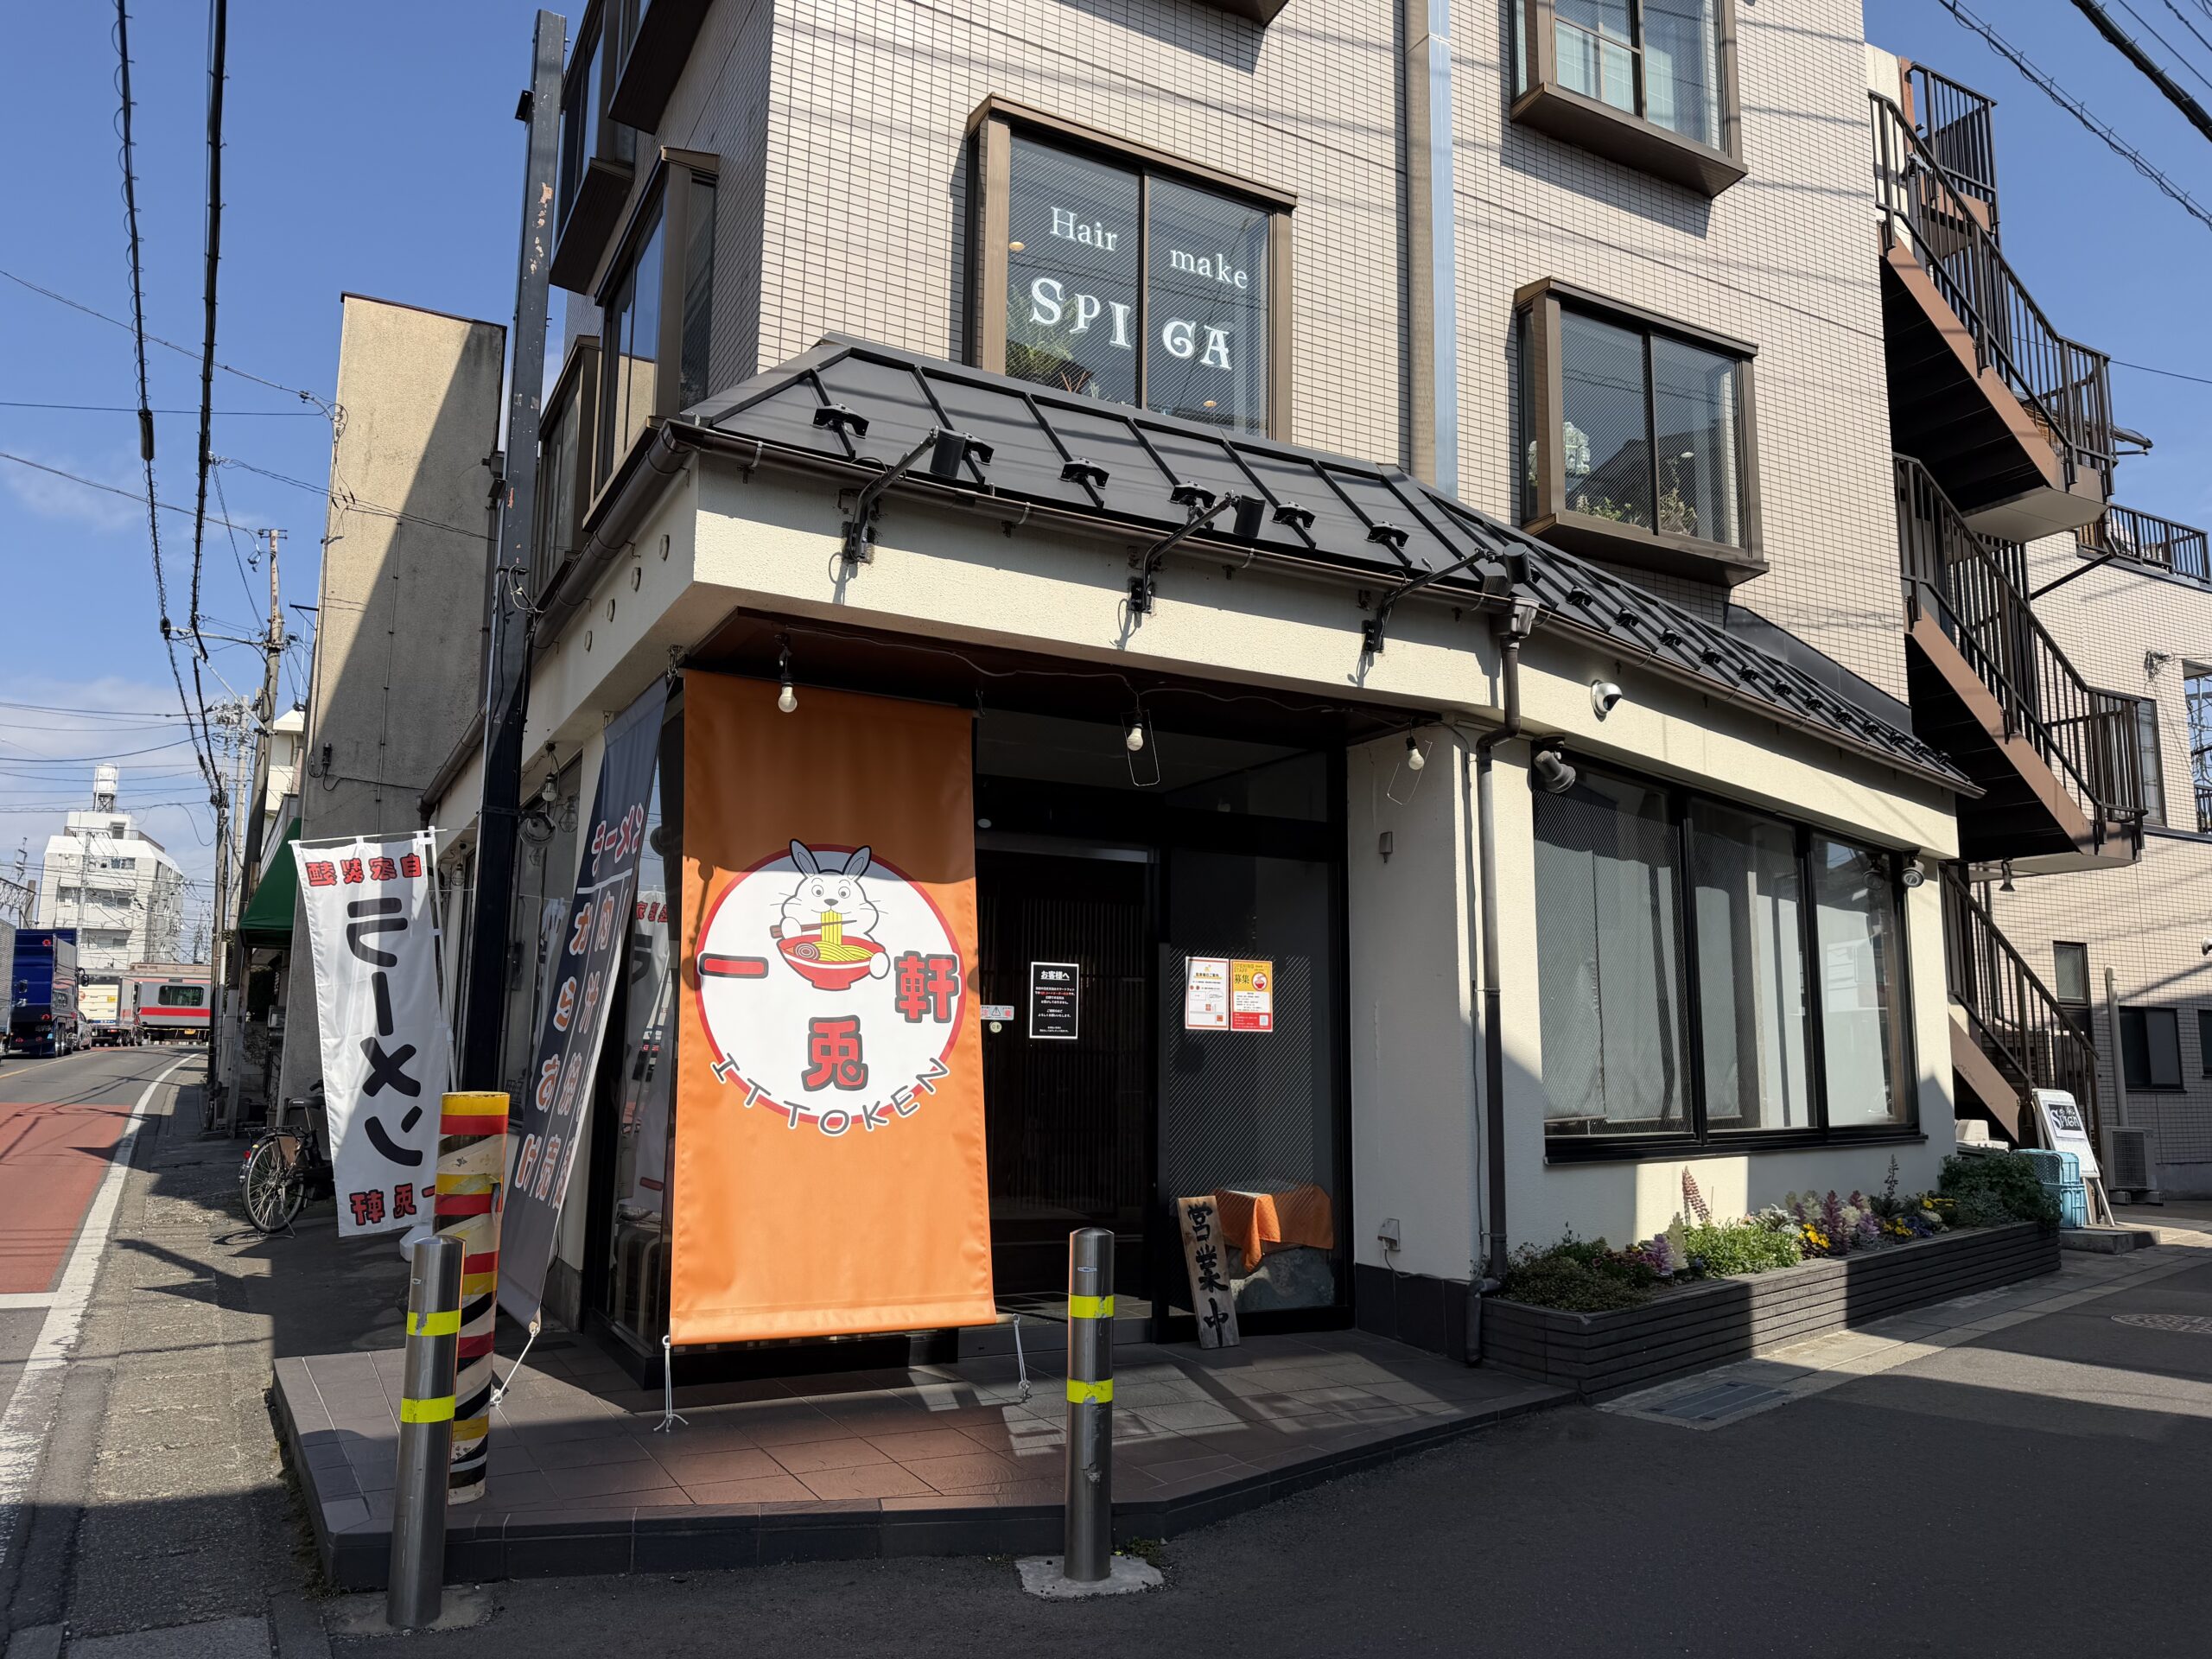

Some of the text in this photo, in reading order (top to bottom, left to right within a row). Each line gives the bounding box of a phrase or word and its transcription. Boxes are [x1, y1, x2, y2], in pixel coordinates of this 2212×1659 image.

[1049, 206, 1249, 289] Hair make
[591, 802, 645, 877] ラーメン
[1040, 970, 1070, 980] お客様へ
[1234, 974, 1249, 984] 募集
[712, 1052, 949, 1134] ITTOKEN
[1187, 1201, 1229, 1348] 営業中
